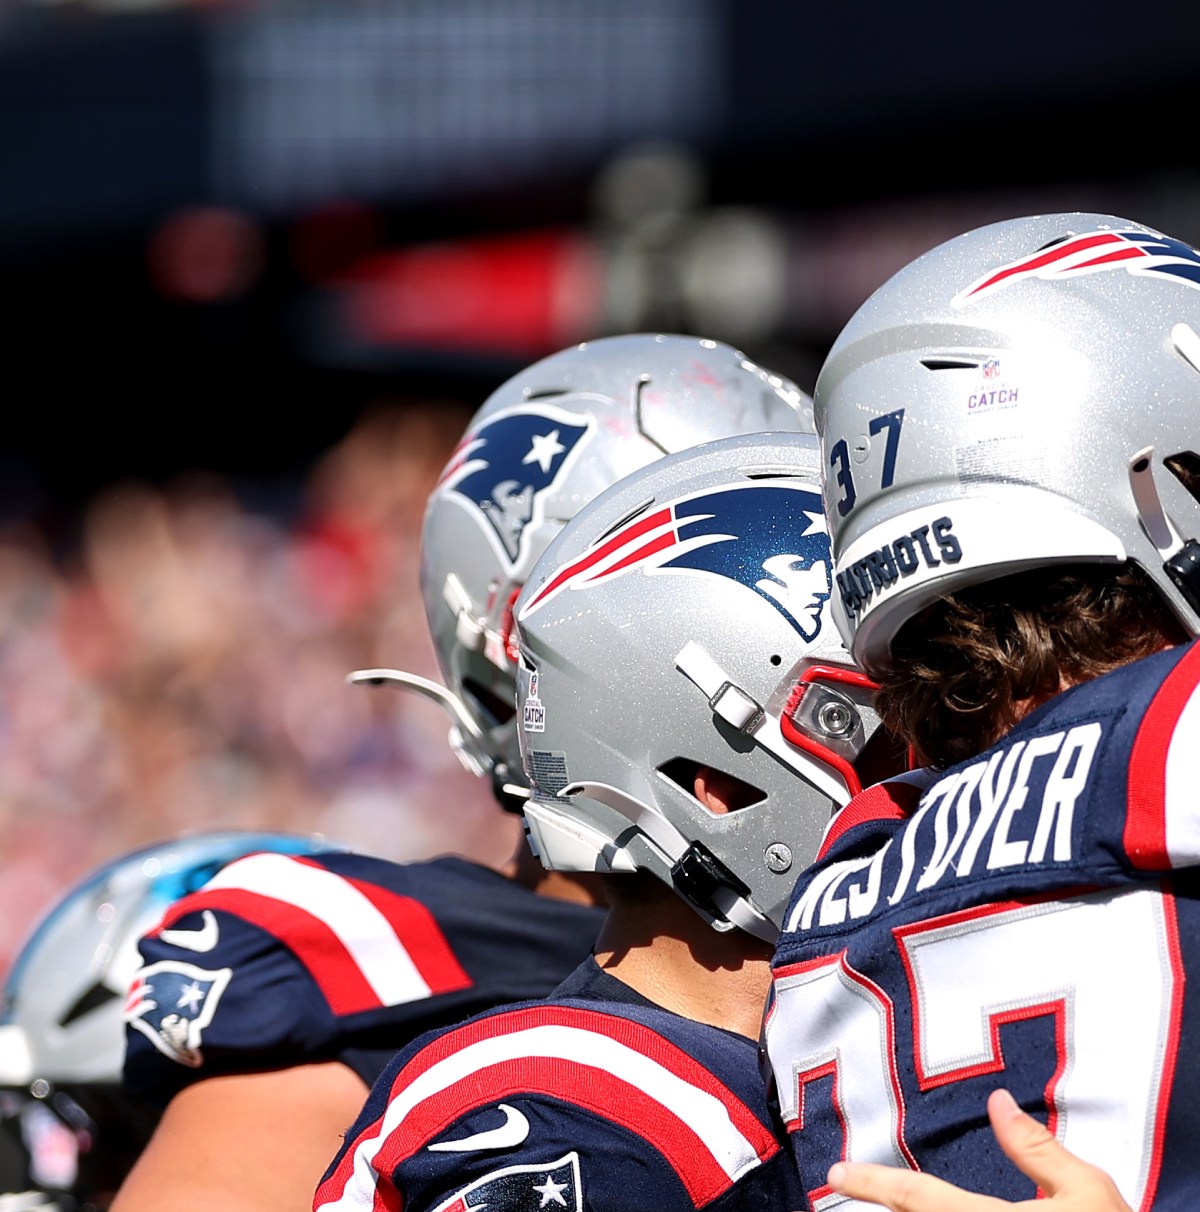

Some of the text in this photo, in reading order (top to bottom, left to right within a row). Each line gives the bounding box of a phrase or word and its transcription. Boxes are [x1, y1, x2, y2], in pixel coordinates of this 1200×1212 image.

[968, 388, 1019, 409] CATCH
[830, 407, 906, 518] 37
[836, 516, 963, 618] PATRIOTS
[525, 707, 544, 723] CATCH
